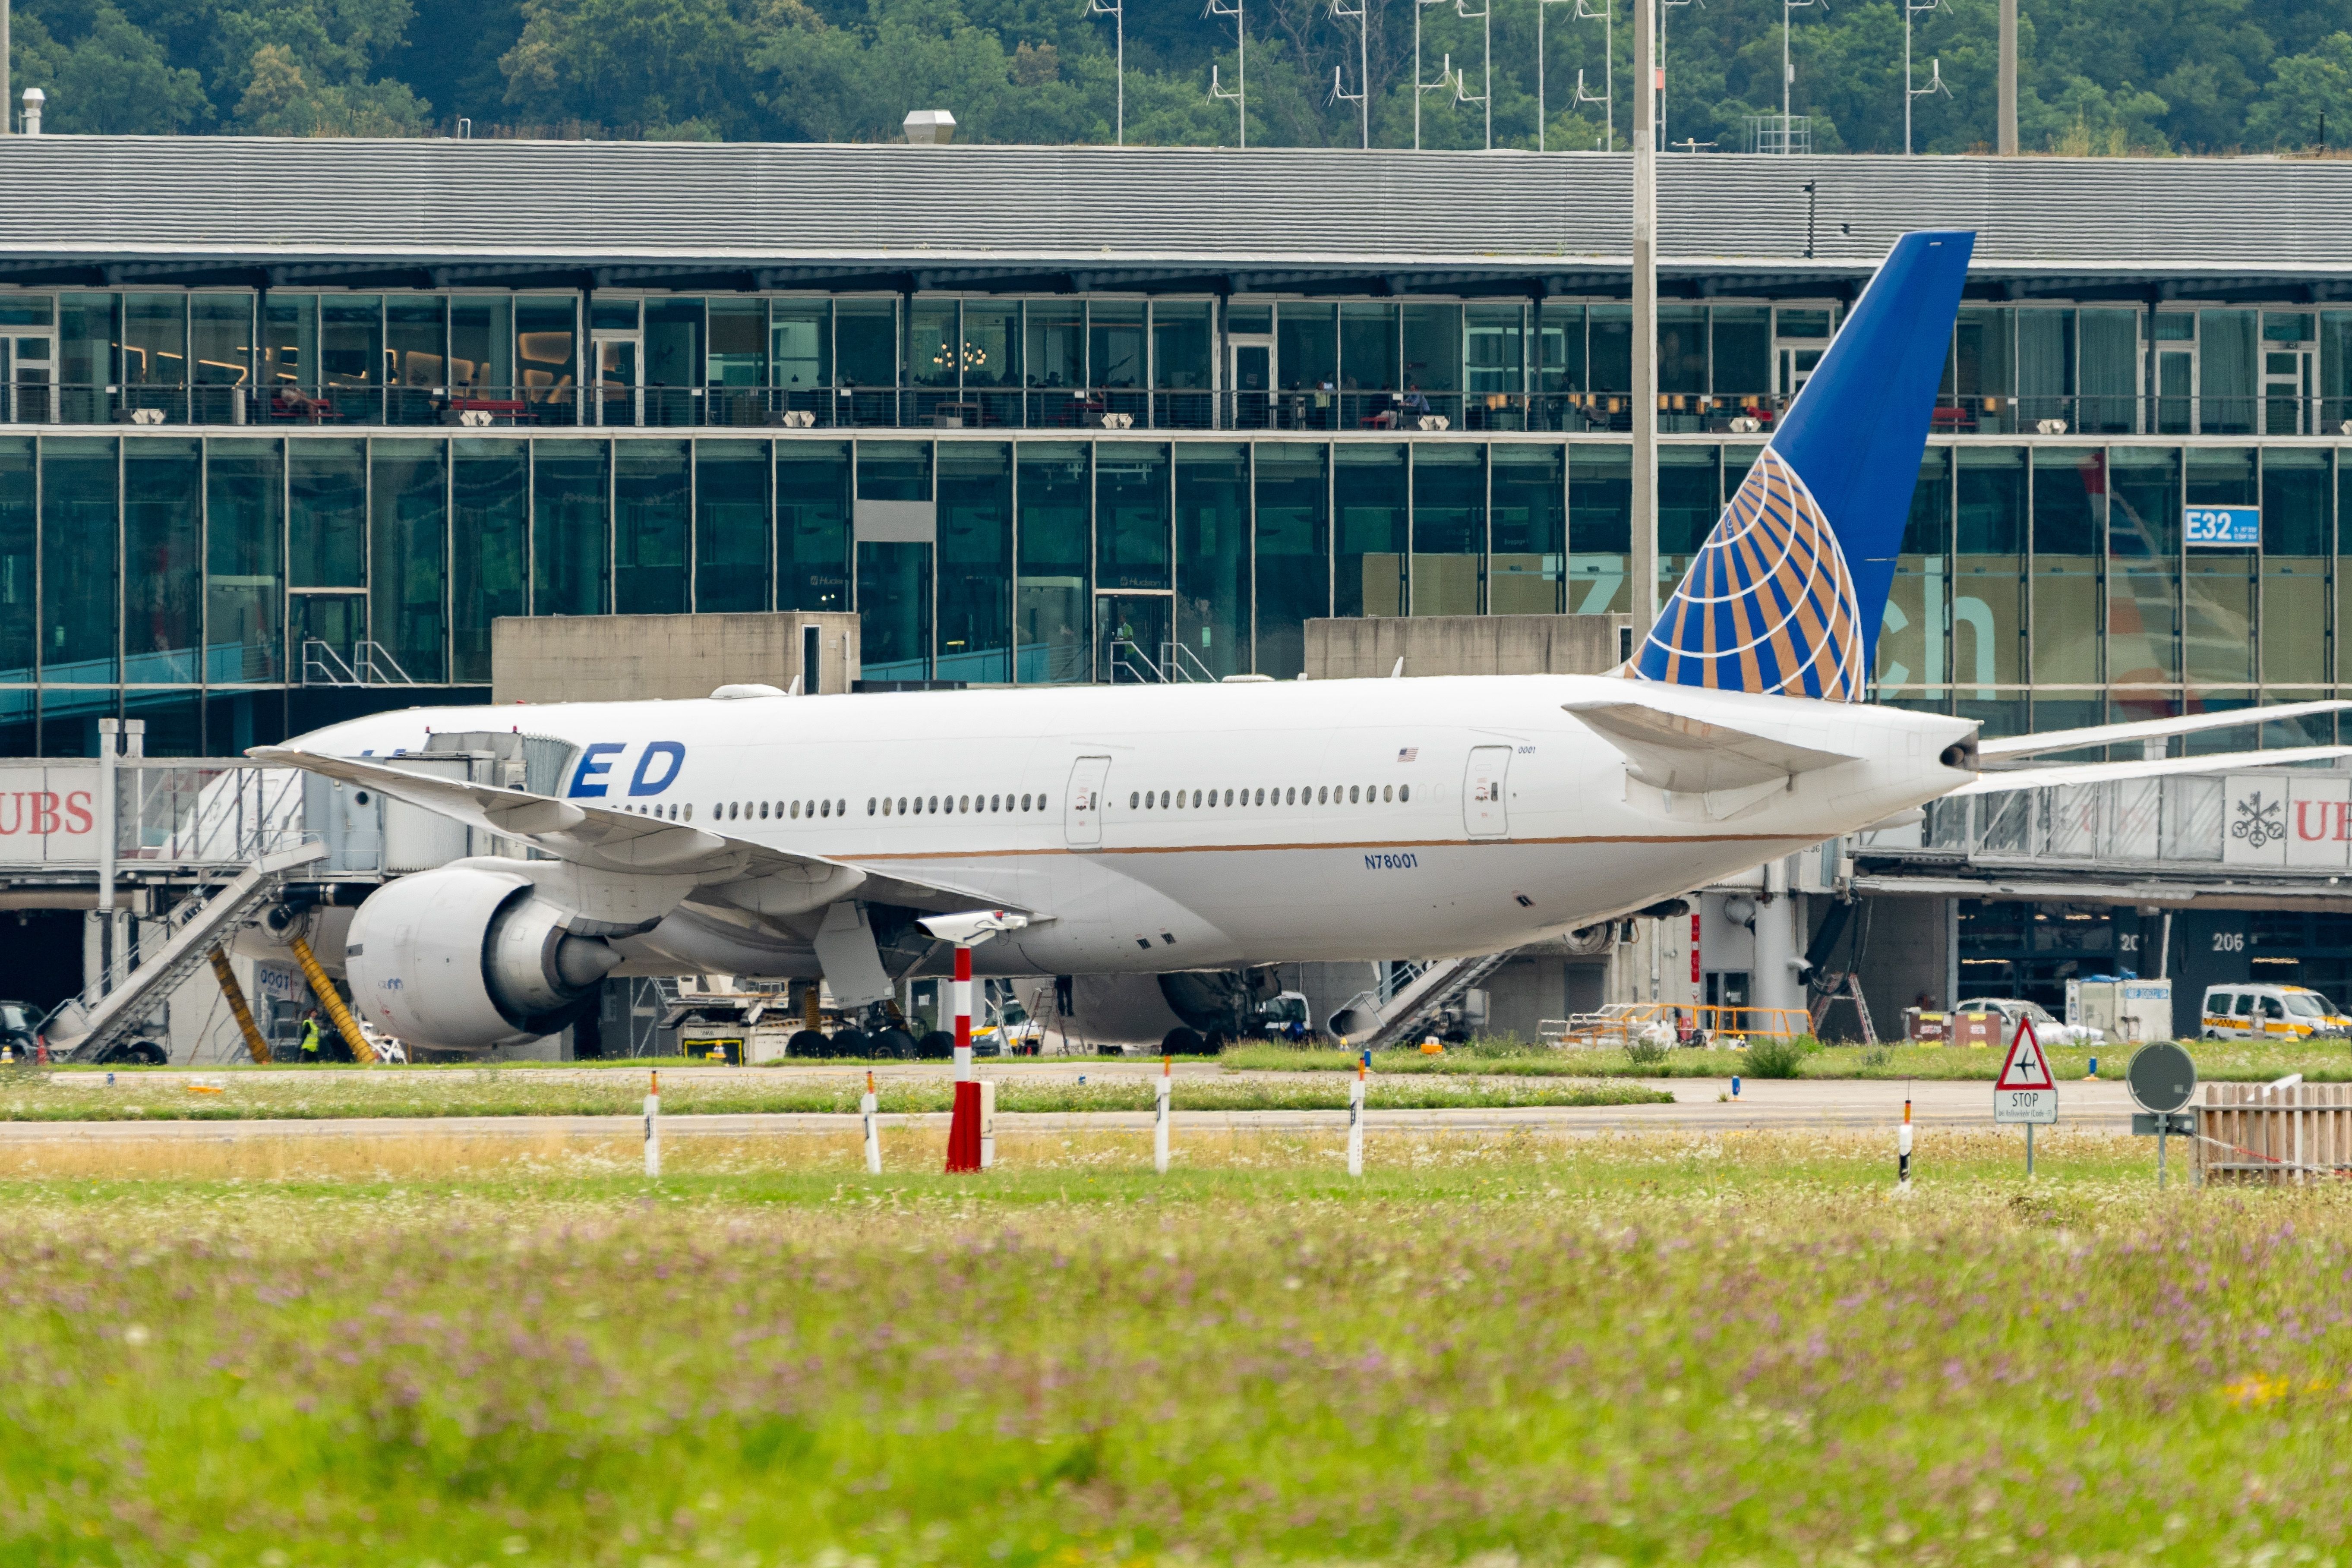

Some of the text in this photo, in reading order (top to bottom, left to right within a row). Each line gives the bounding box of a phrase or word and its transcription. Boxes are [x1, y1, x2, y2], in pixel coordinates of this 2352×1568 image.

[2187, 511, 2232, 539] E32
[0, 791, 92, 835] UBS
[1364, 853, 1418, 870] N78001
[2213, 932, 2245, 952] 206
[2012, 1092, 2039, 1107] STOP
